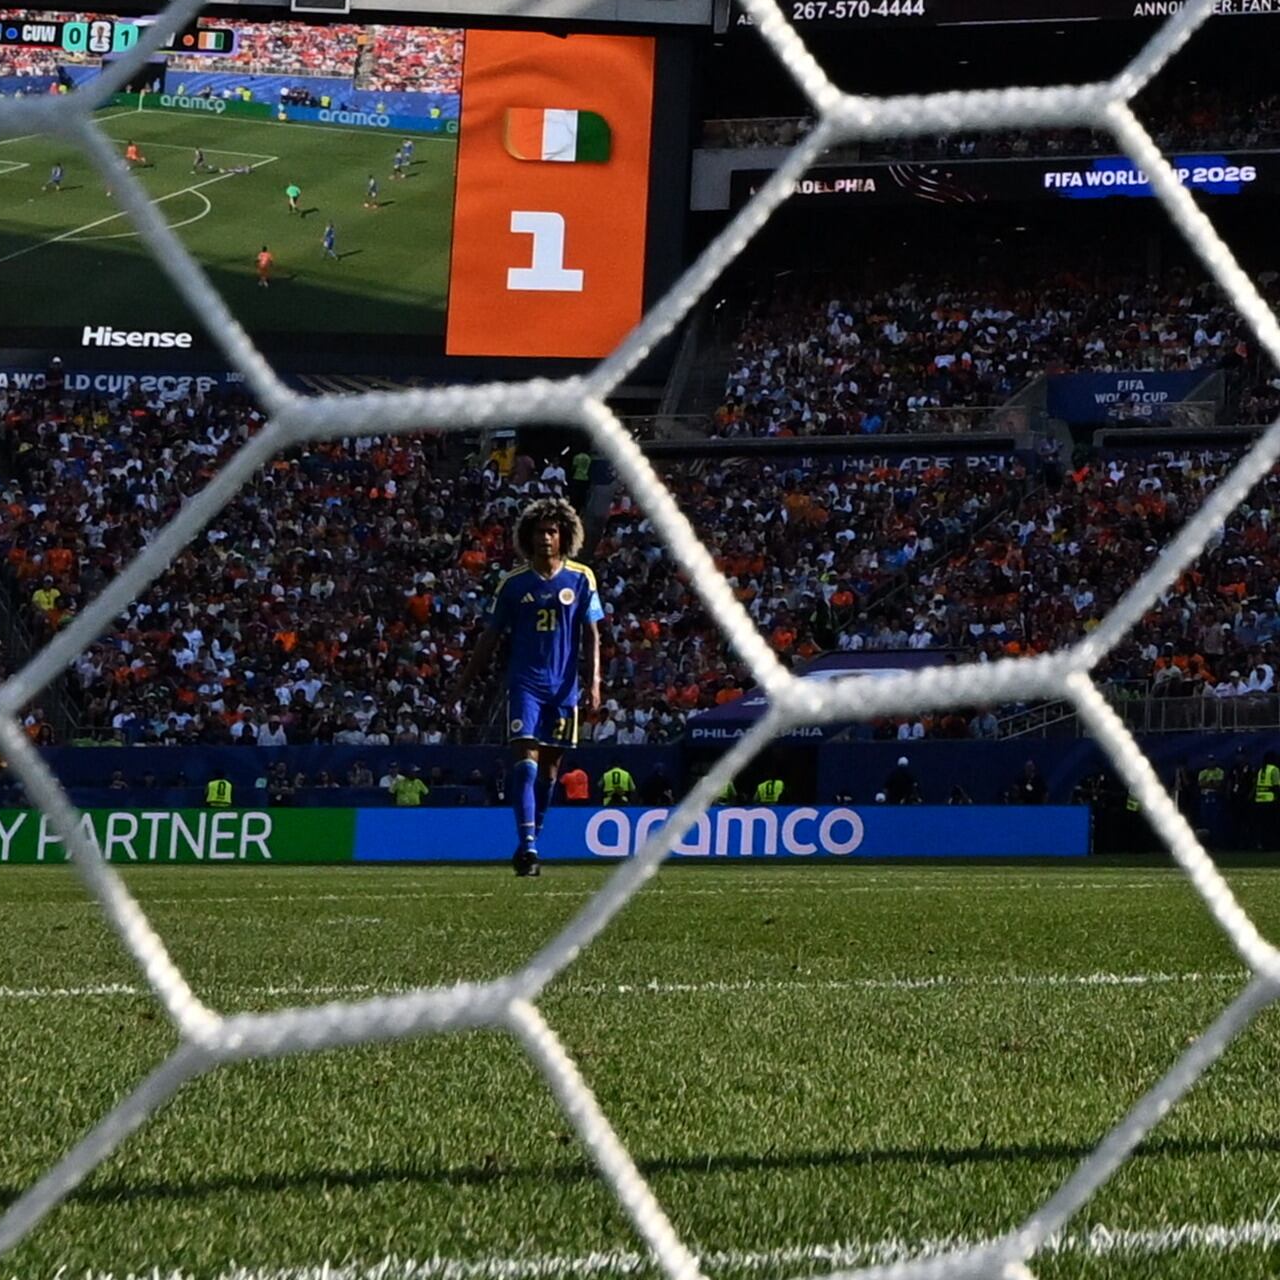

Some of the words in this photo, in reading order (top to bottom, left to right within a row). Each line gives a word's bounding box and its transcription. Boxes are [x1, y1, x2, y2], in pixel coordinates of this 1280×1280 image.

[22, 24, 56, 42] CUW
[69, 27, 81, 45] 0
[120, 29, 130, 47] 1
[160, 93, 226, 113] aramco
[318, 108, 390, 128] aramco
[1044, 172, 1084, 187] FIFA
[1085, 170, 1149, 187] WORLD
[1192, 166, 1257, 183] 2026
[507, 210, 584, 292] 1
[81, 325, 192, 348] Hisense
[1117, 379, 1145, 391] FIFA
[1142, 391, 1168, 403] CUP
[536, 608, 557, 632] 21
